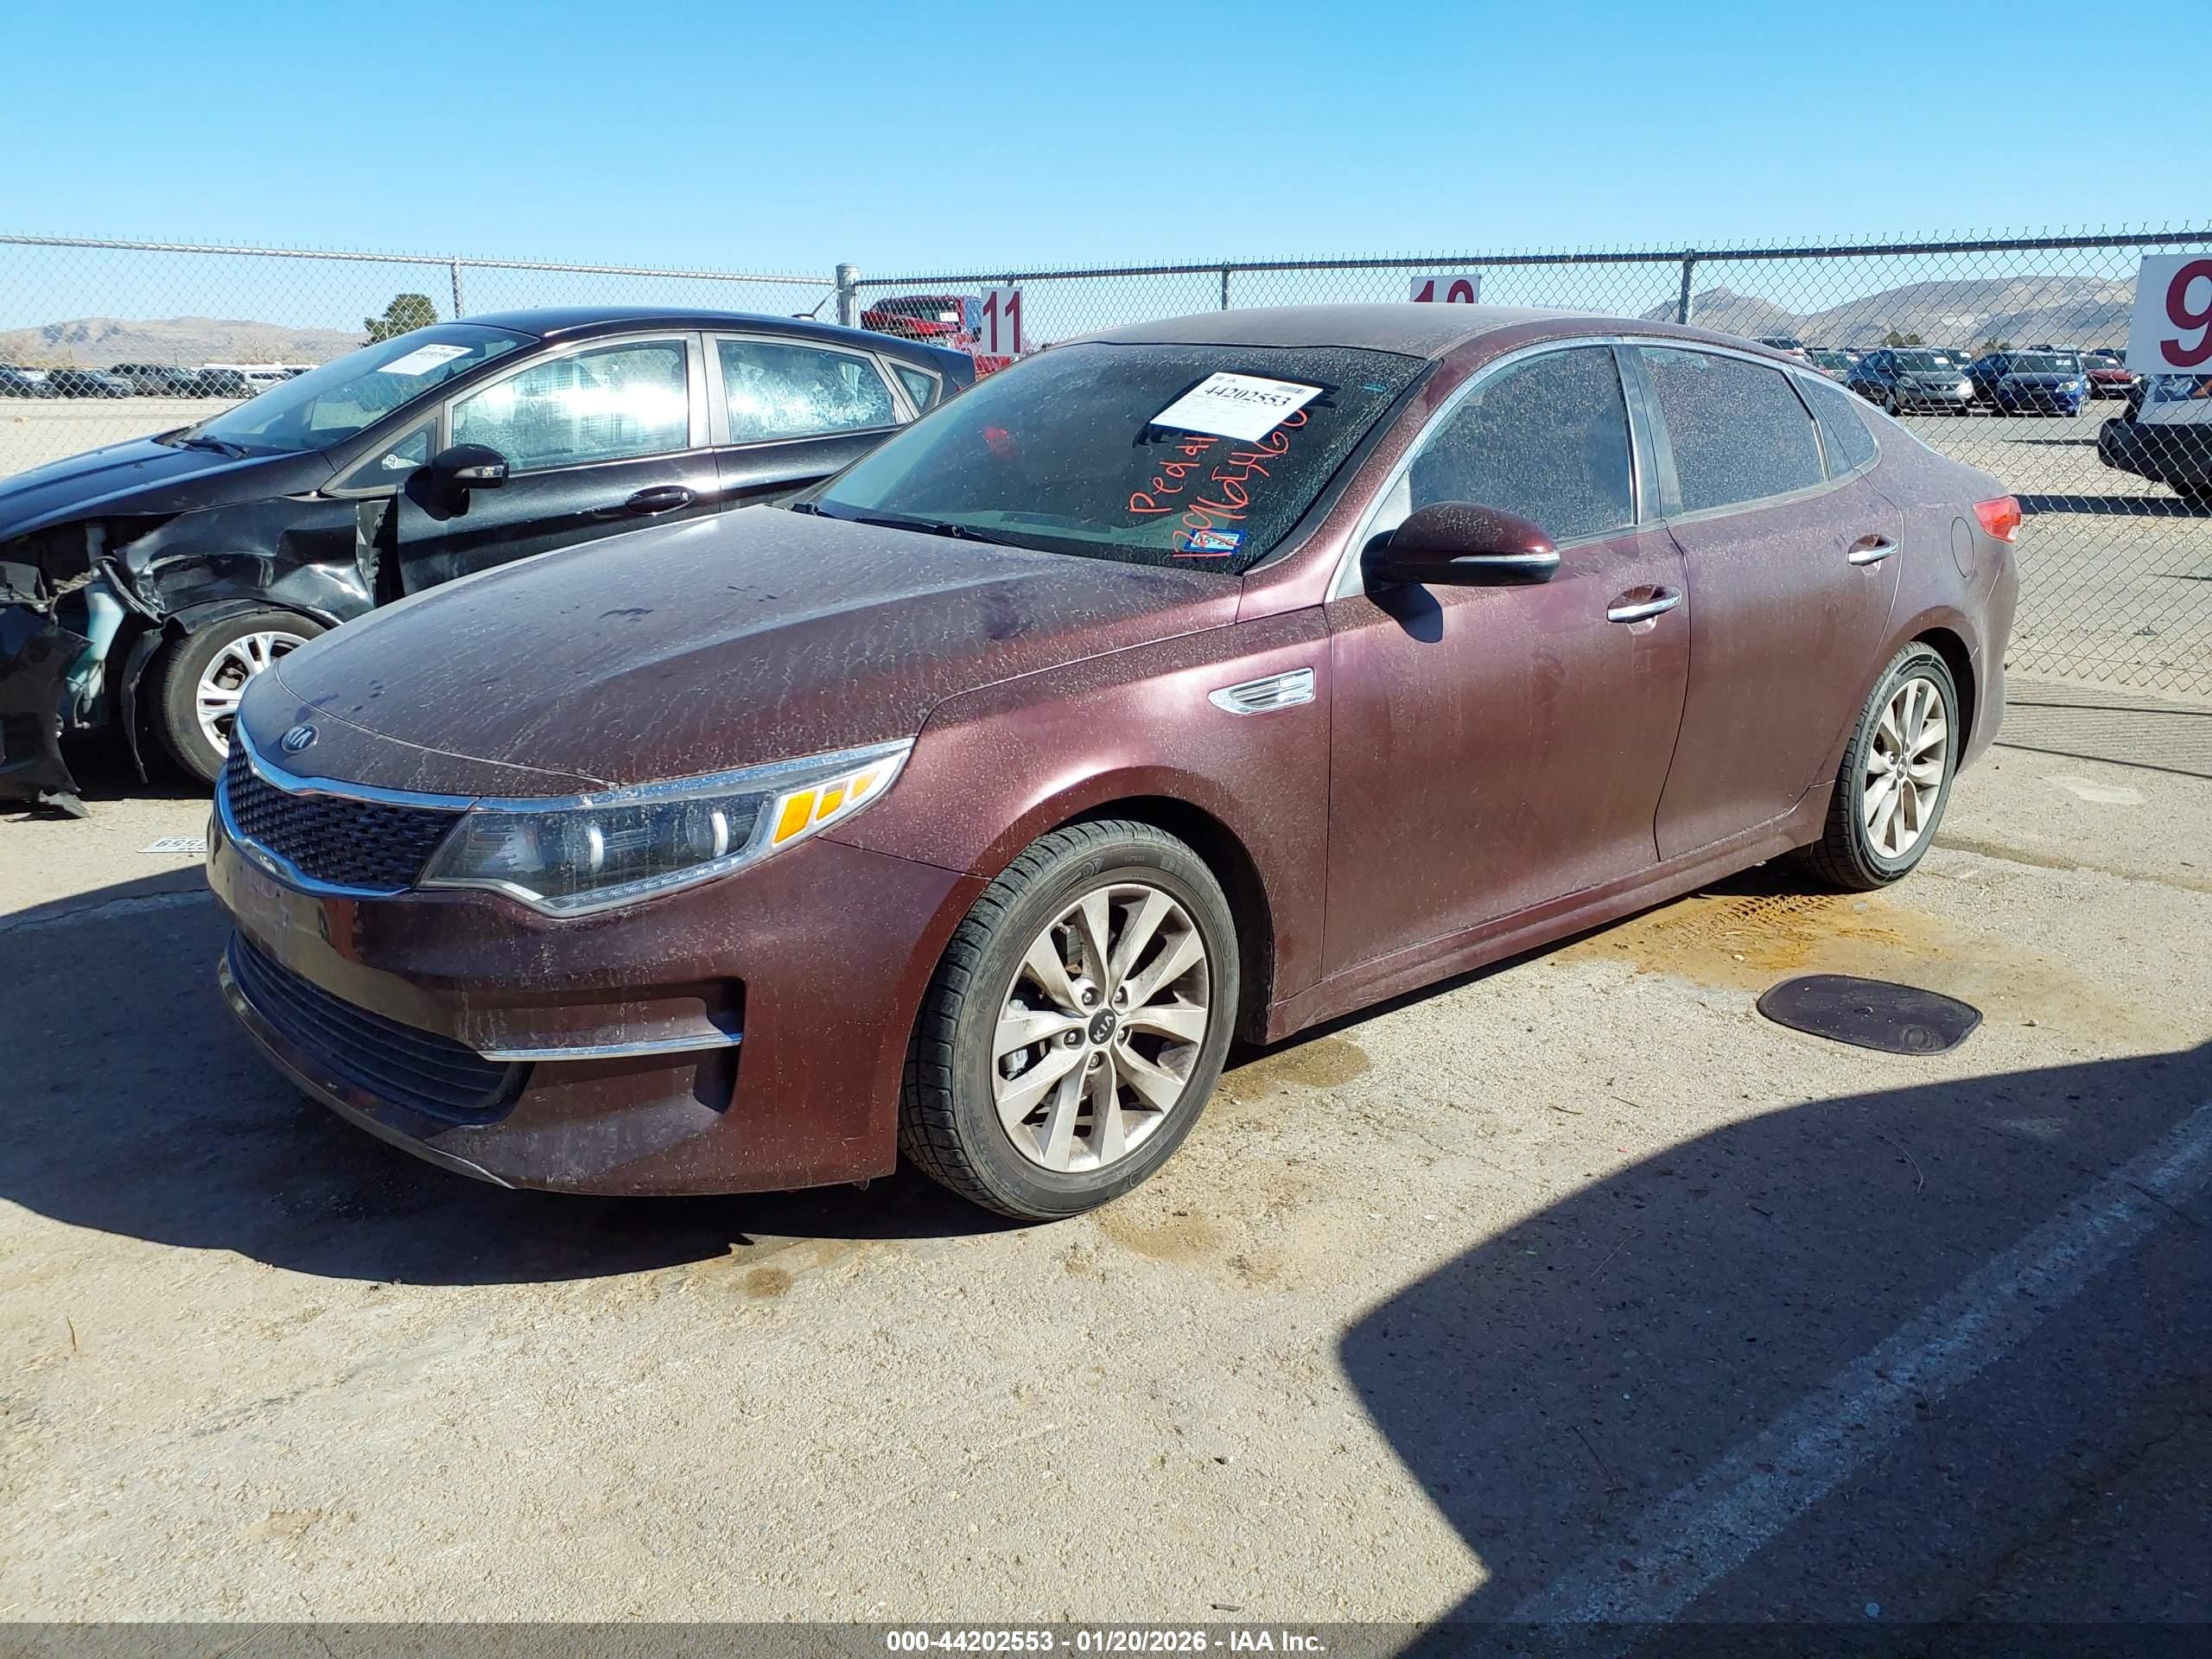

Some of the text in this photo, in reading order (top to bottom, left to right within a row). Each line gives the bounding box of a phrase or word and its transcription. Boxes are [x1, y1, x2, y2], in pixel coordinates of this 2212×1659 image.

[982, 291, 1021, 353] 11
[2160, 259, 2212, 367] 9
[1204, 385, 1292, 407] 44202553
[284, 725, 313, 748] KIA
[1092, 1015, 1114, 1042] KIA
